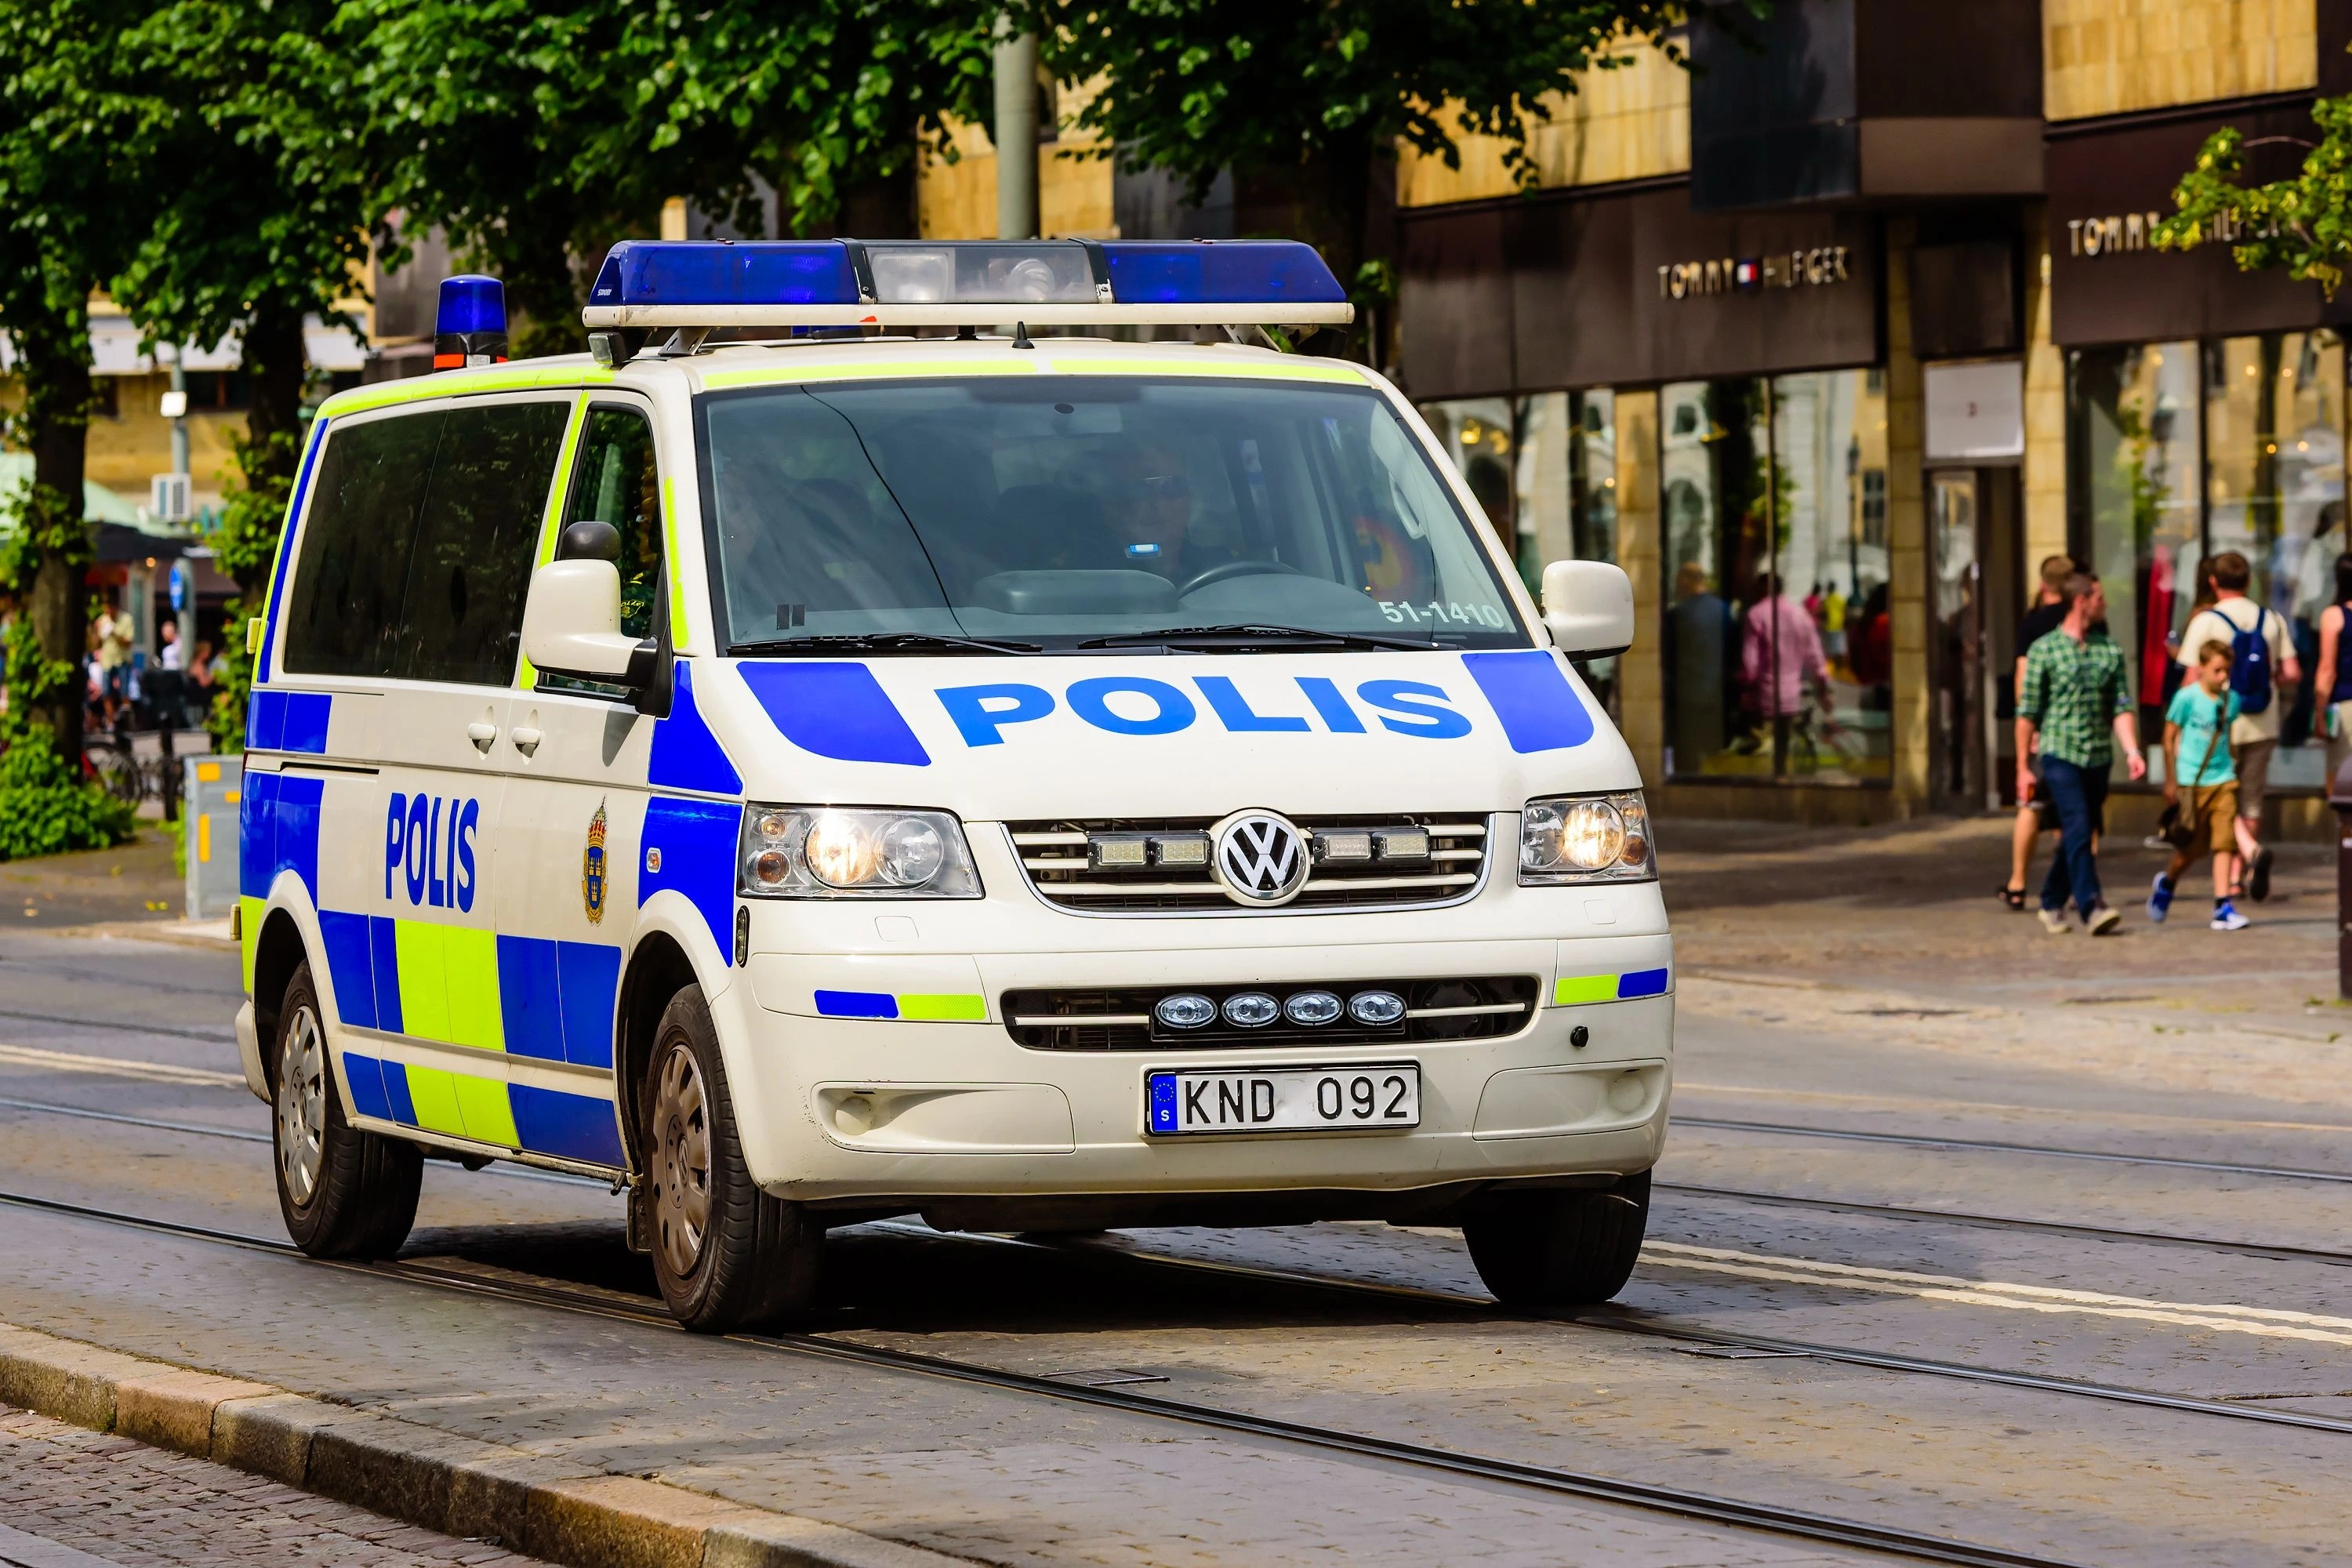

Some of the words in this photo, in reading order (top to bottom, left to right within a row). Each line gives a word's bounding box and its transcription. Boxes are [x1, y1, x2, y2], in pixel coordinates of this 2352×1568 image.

[1657, 258, 1734, 299] TOMMY
[1763, 247, 1848, 288] HILFIGER
[1378, 601, 1504, 629] 51-1410
[934, 676, 1473, 748] POLIS
[386, 792, 479, 913] POLIS
[1161, 1109, 1170, 1122] S
[1185, 1079, 1275, 1124] KND
[1317, 1075, 1407, 1120] 092
